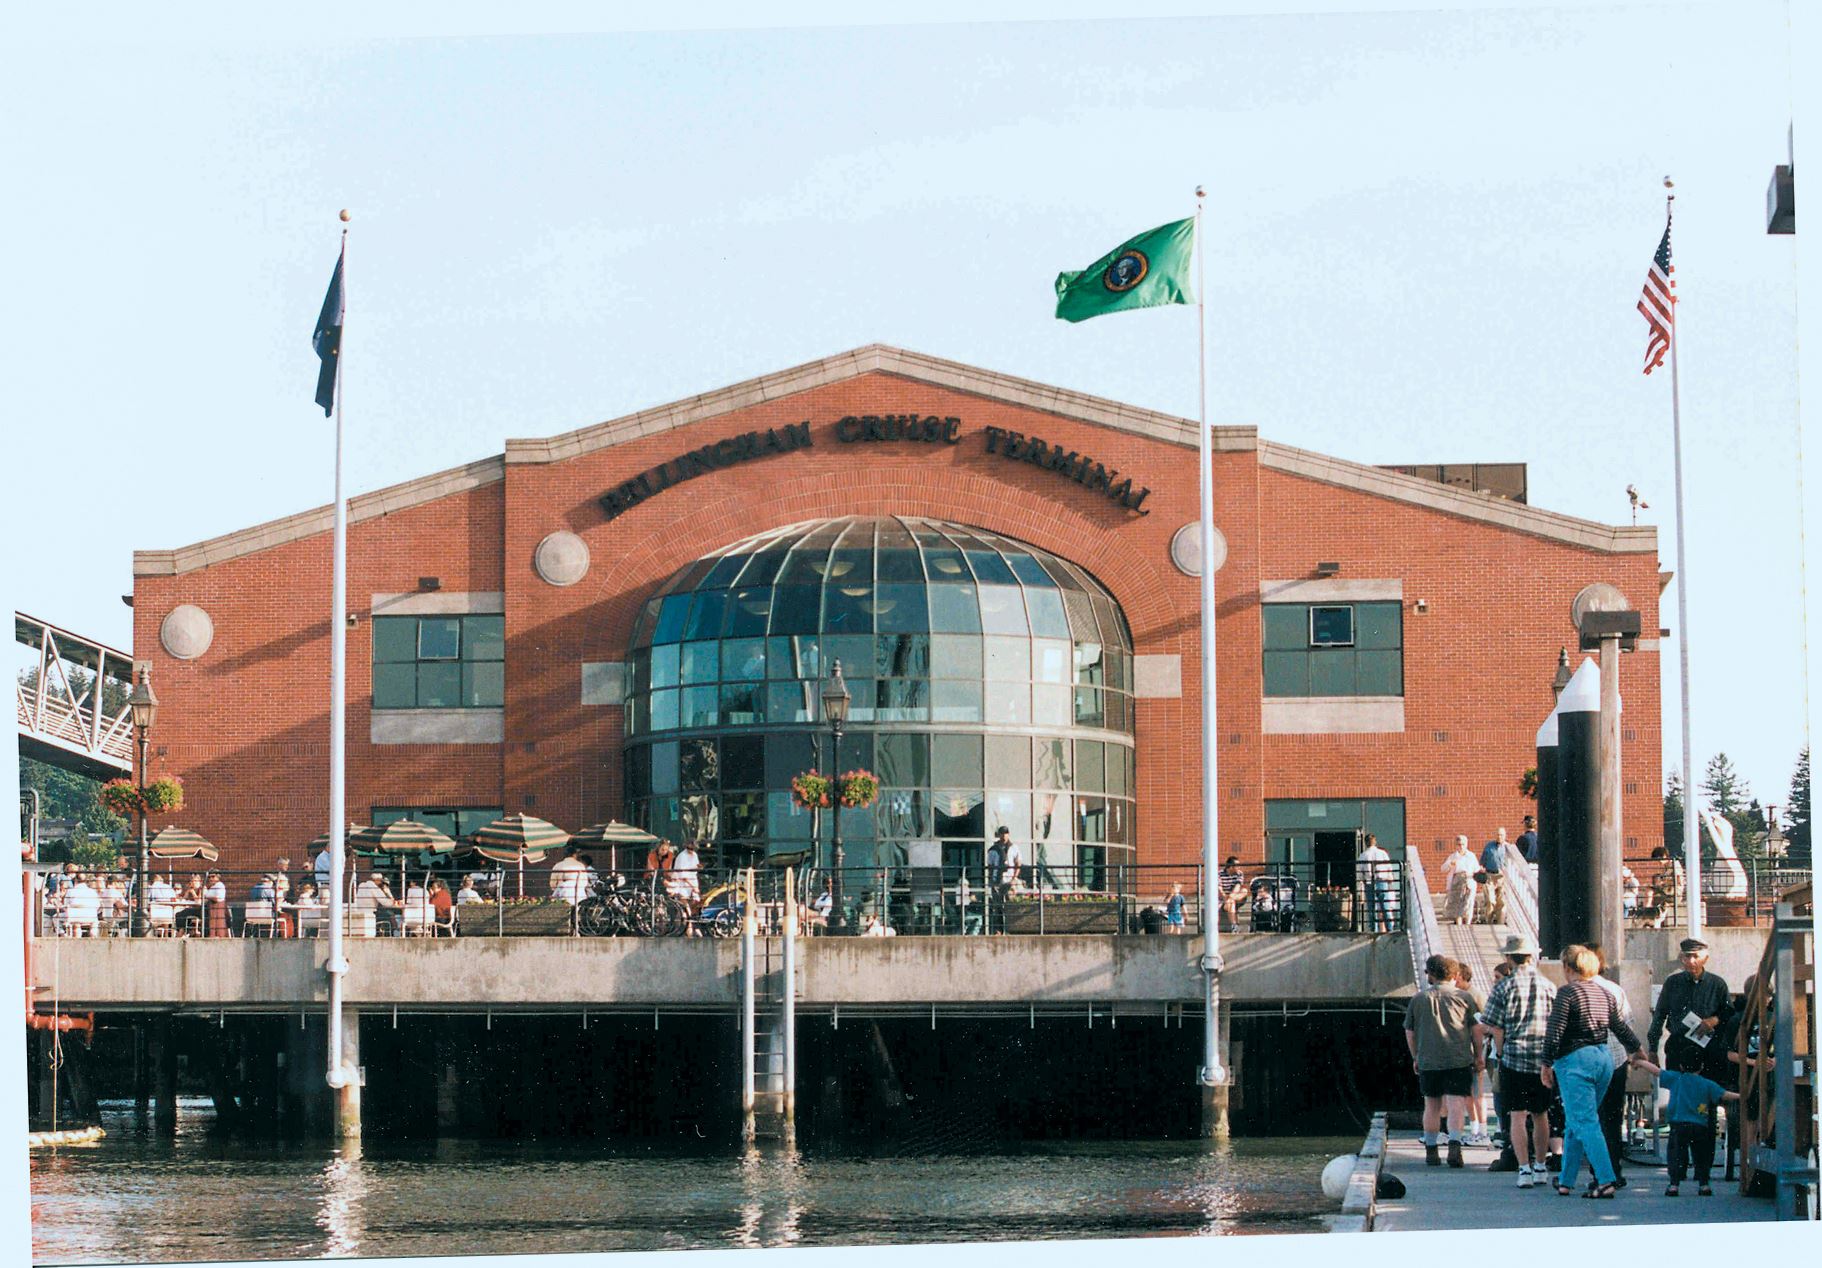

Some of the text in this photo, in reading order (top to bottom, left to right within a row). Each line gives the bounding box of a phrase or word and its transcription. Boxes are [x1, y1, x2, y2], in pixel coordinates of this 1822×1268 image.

[601, 413, 1151, 521] BELLINGHAM CRUISE TERMINAL
